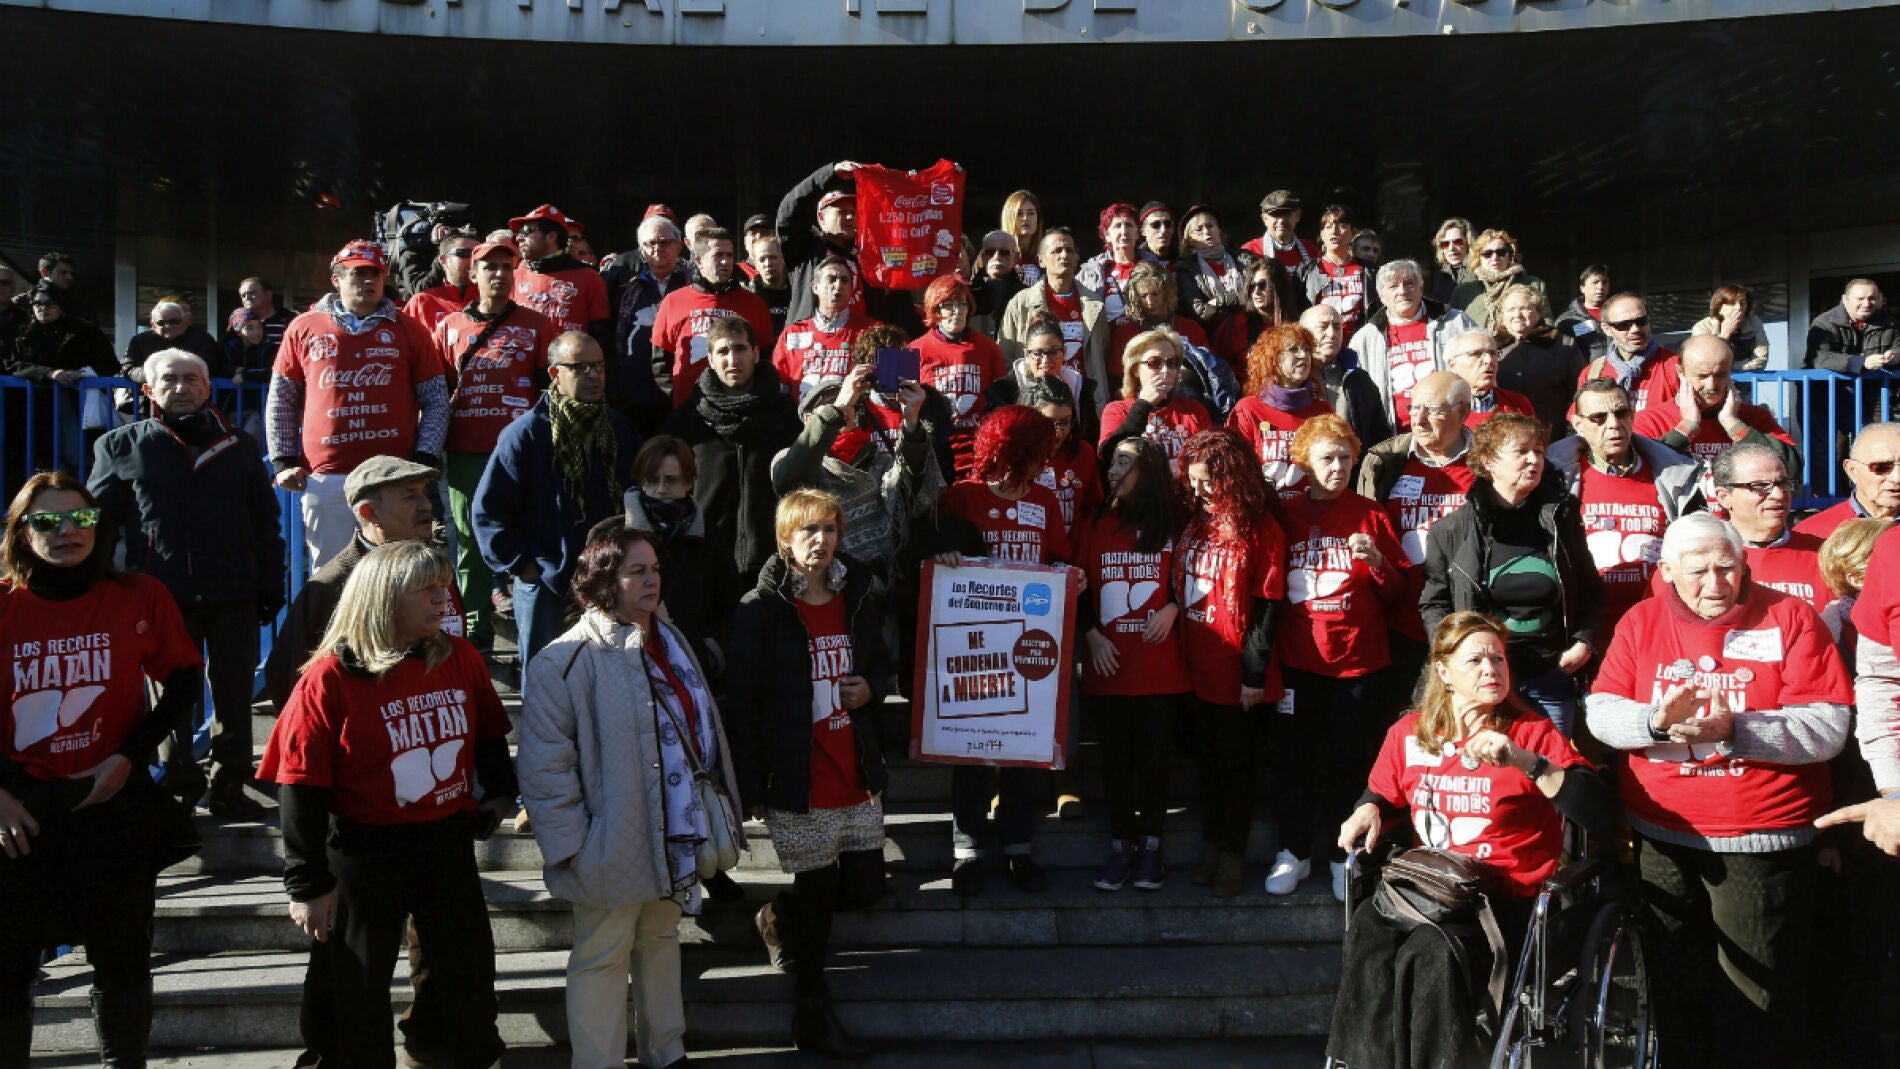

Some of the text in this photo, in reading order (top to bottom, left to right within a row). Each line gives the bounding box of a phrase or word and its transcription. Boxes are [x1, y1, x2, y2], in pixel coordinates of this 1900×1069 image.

[473, 374, 487, 382] NI
[935, 373, 981, 393] MATAN
[348, 392, 365, 402] NI
[327, 404, 388, 418] CIERRES
[349, 419, 365, 428] NI
[321, 428, 399, 446] DESPIDOS
[1421, 494, 1467, 506] RECORTES
[1584, 503, 1660, 519] TRATAMIENTO
[982, 530, 1041, 543] LOS RECORTES
[1290, 547, 1353, 570] MATAN
[952, 581, 1018, 598] Los Recortes
[948, 597, 1021, 613] del Gobierno del
[13, 632, 110, 659] LOS RECRTES
[968, 630, 985, 650] ME
[13, 648, 111, 693] MATAN
[946, 652, 1009, 674] CONDENAN
[941, 671, 1017, 704] A MUERTE
[380, 699, 405, 720] LOS
[385, 704, 469, 753] MATAN
